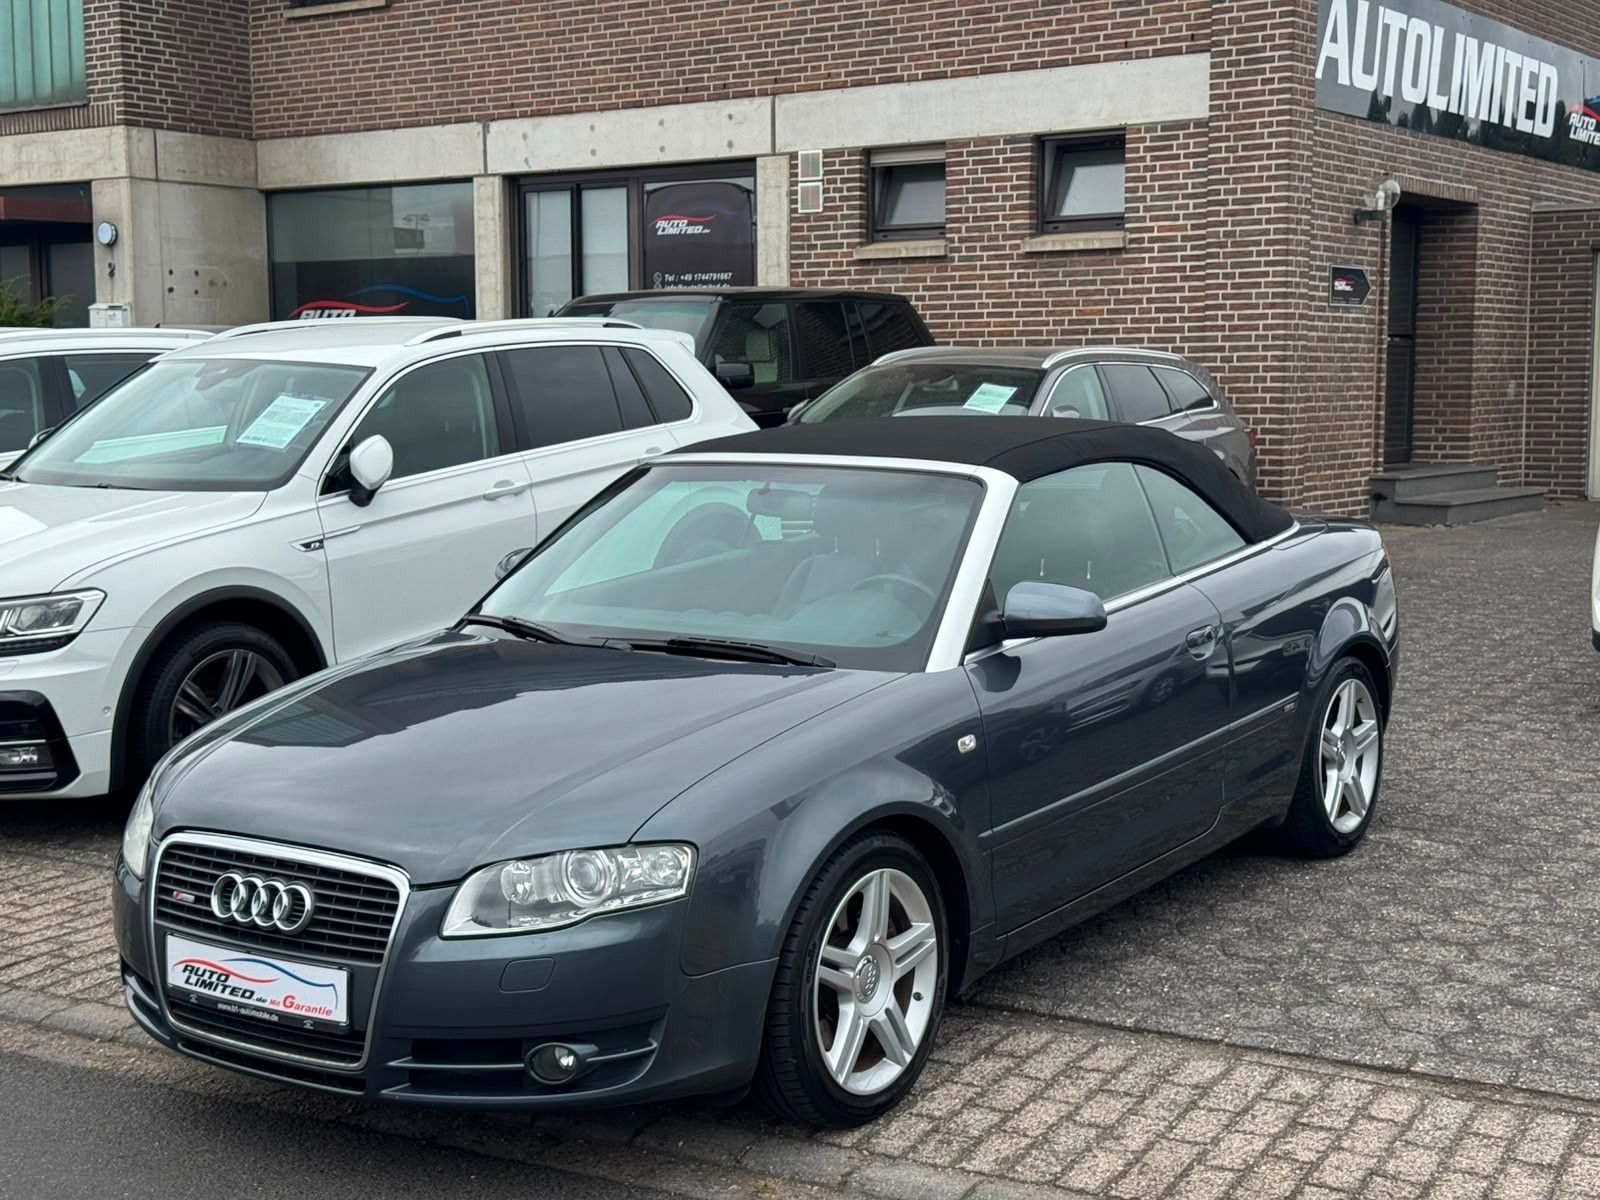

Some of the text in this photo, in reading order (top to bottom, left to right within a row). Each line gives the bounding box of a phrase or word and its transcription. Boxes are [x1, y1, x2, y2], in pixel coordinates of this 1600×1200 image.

[1315, 0, 1558, 138] AUTOLIMITED
[1569, 113, 1597, 131] AUTO
[656, 219, 688, 228] AUTO
[182, 964, 231, 982] AUTO
[184, 975, 268, 1003] LIMITED.de
[282, 994, 333, 1017] Garantie
